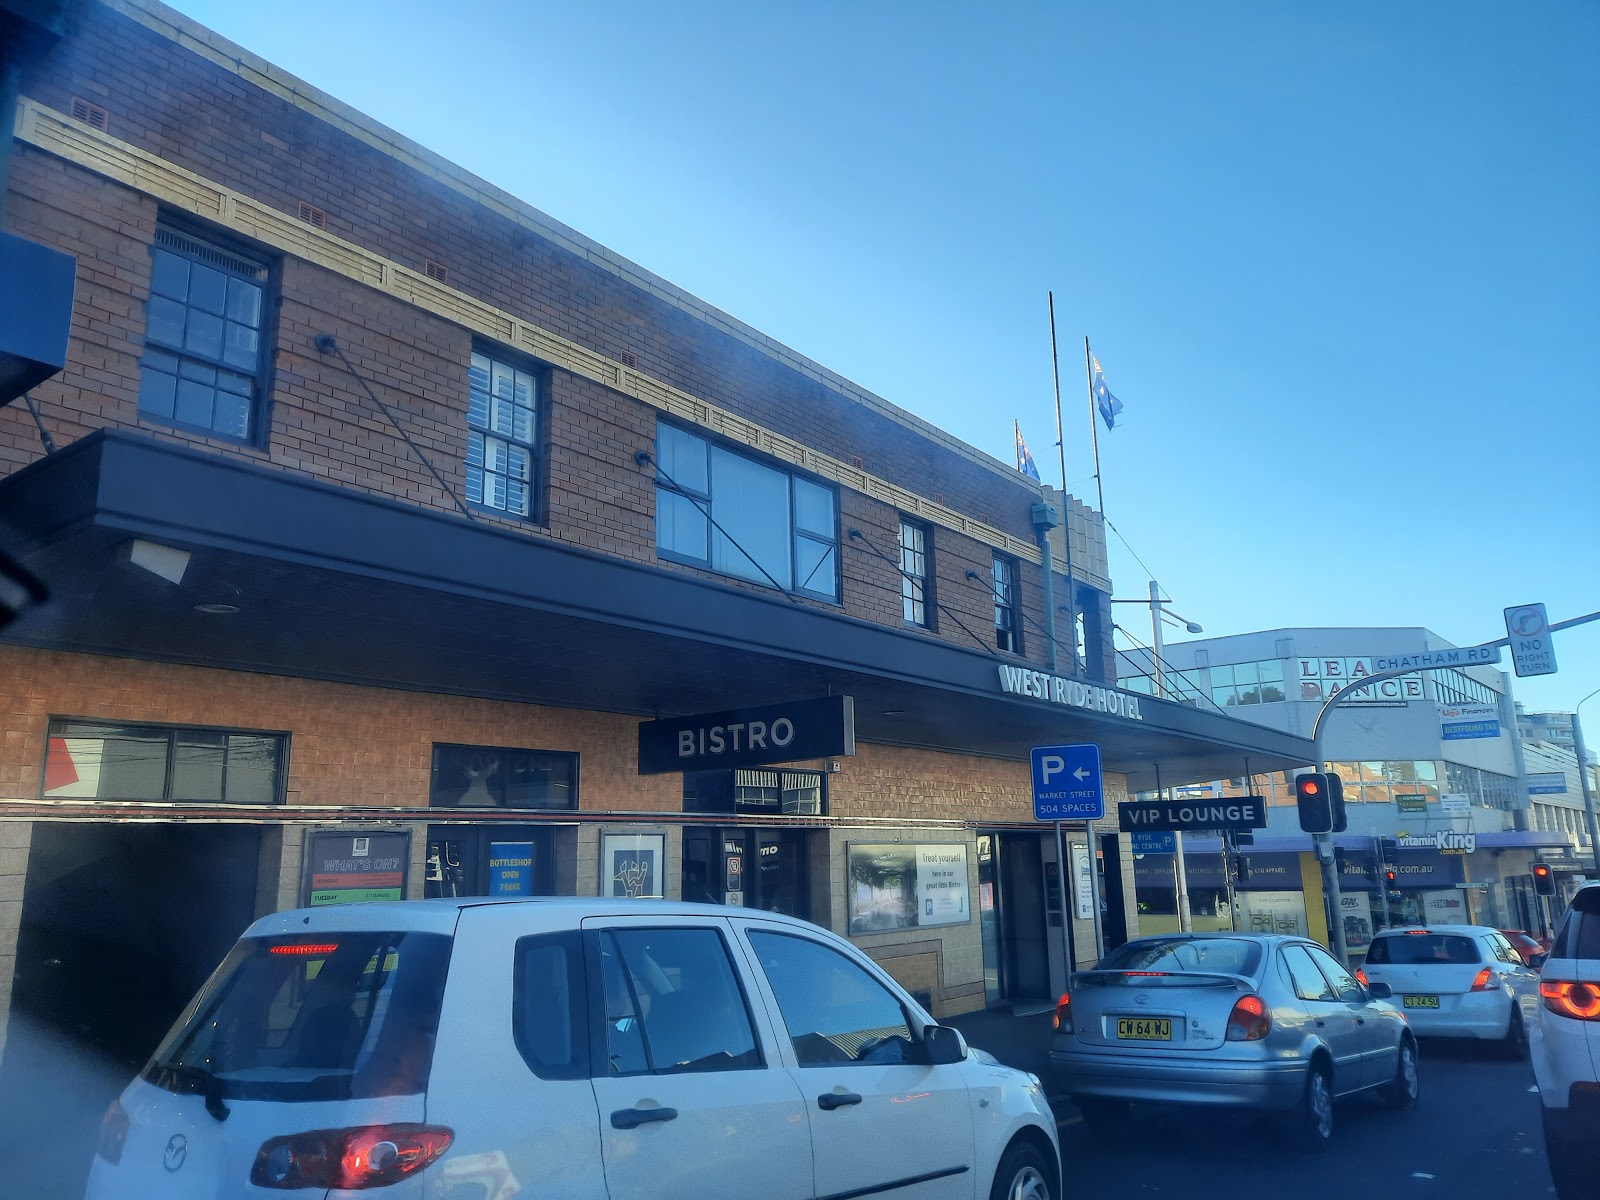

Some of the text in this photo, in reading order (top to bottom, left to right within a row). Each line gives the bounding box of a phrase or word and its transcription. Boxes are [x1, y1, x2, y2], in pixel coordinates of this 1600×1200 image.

[1520, 640, 1542, 651] NO
[1377, 648, 1490, 669] CHATHAM RD
[1517, 651, 1550, 662] RIGHT
[1520, 662, 1550, 672] TURN
[998, 664, 1143, 720] WEST RYDE HOTEL
[1461, 707, 1495, 716] Finances
[678, 717, 795, 758] BISTRO
[1041, 755, 1065, 785] P
[1039, 790, 1096, 800] MARKET STREET
[1040, 803, 1097, 814] 504 SPACES
[1128, 805, 1255, 825] VIP LOUNGE
[1141, 842, 1163, 850] CENTRE
[324, 857, 400, 872] WHAT'S ON?
[489, 858, 532, 868] BOTTLESHOP
[922, 853, 961, 865] Treat yourself
[501, 870, 520, 879] OPEN
[505, 882, 520, 890] DAYS
